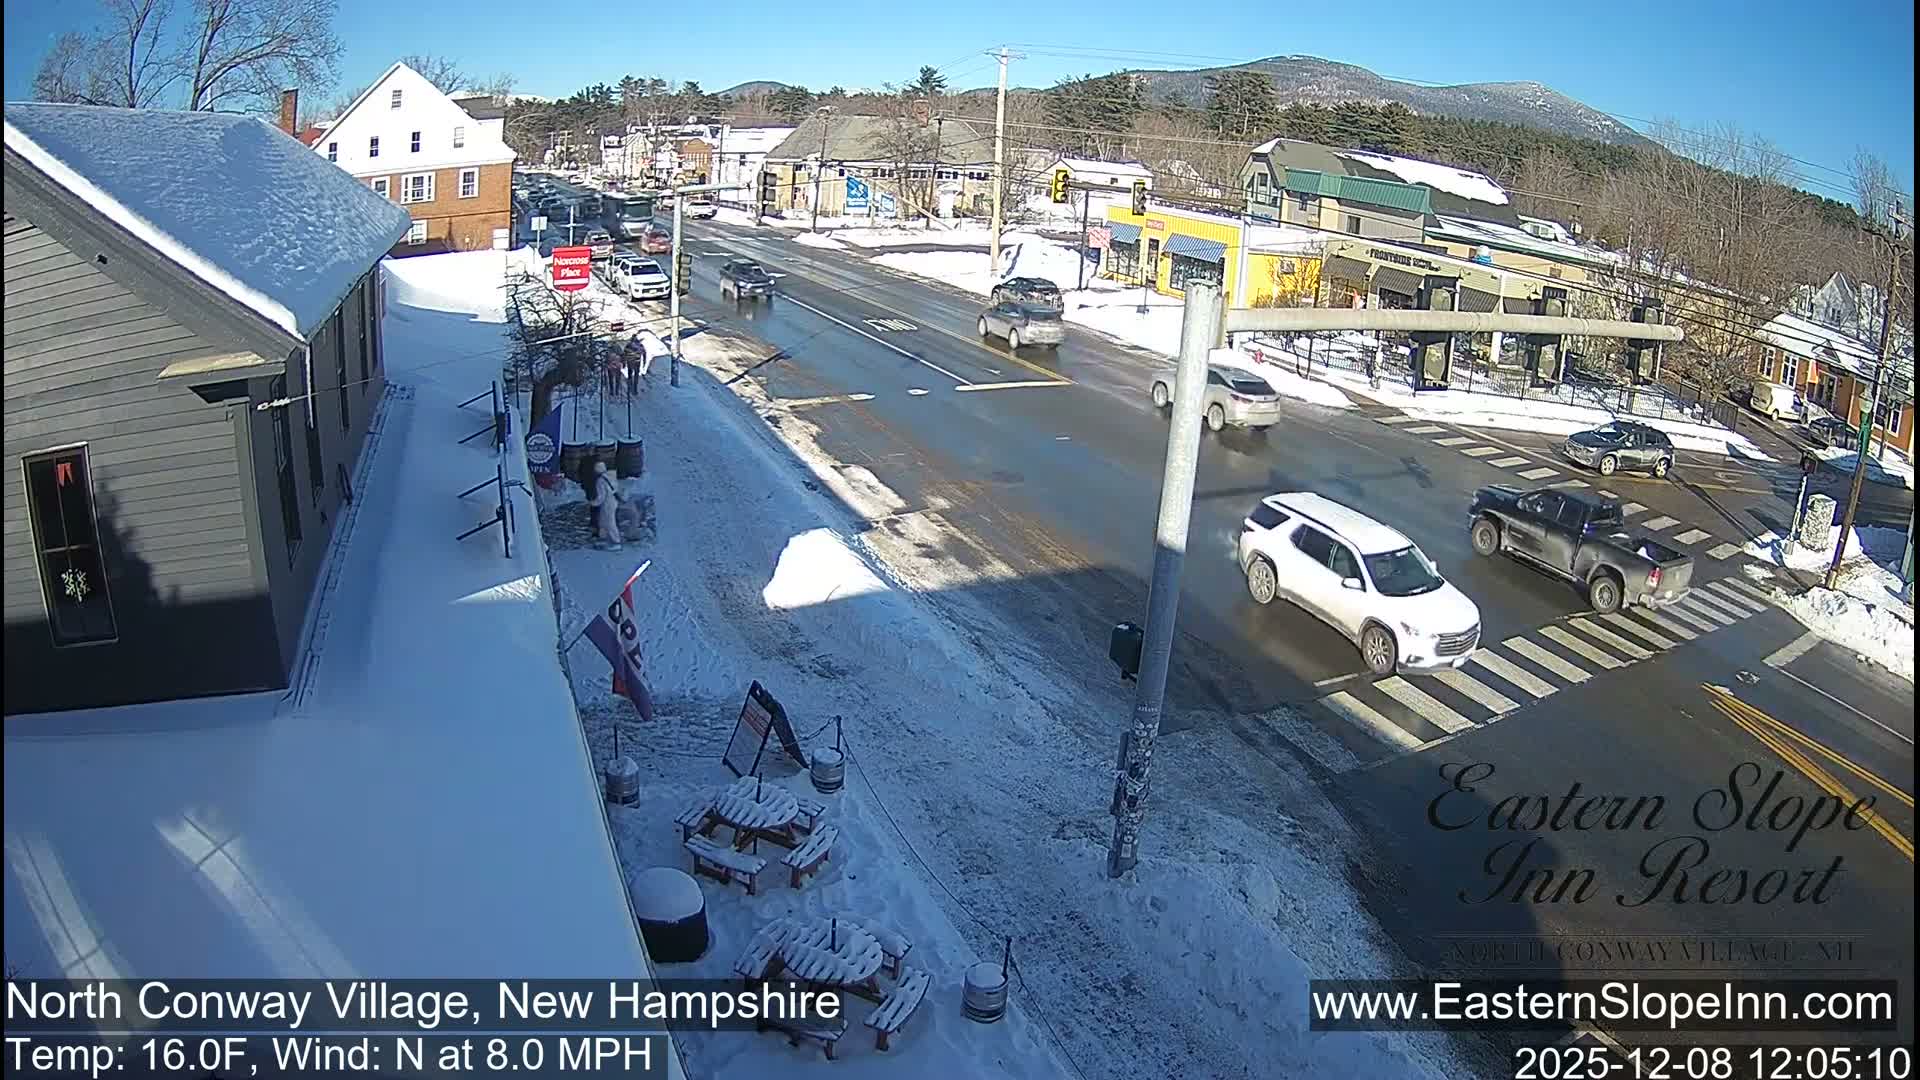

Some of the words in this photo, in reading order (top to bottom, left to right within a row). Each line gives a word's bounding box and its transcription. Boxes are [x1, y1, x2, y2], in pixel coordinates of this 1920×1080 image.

[554, 256, 589, 266] Norcross
[560, 267, 582, 277] Place
[862, 319, 918, 332] ONLY
